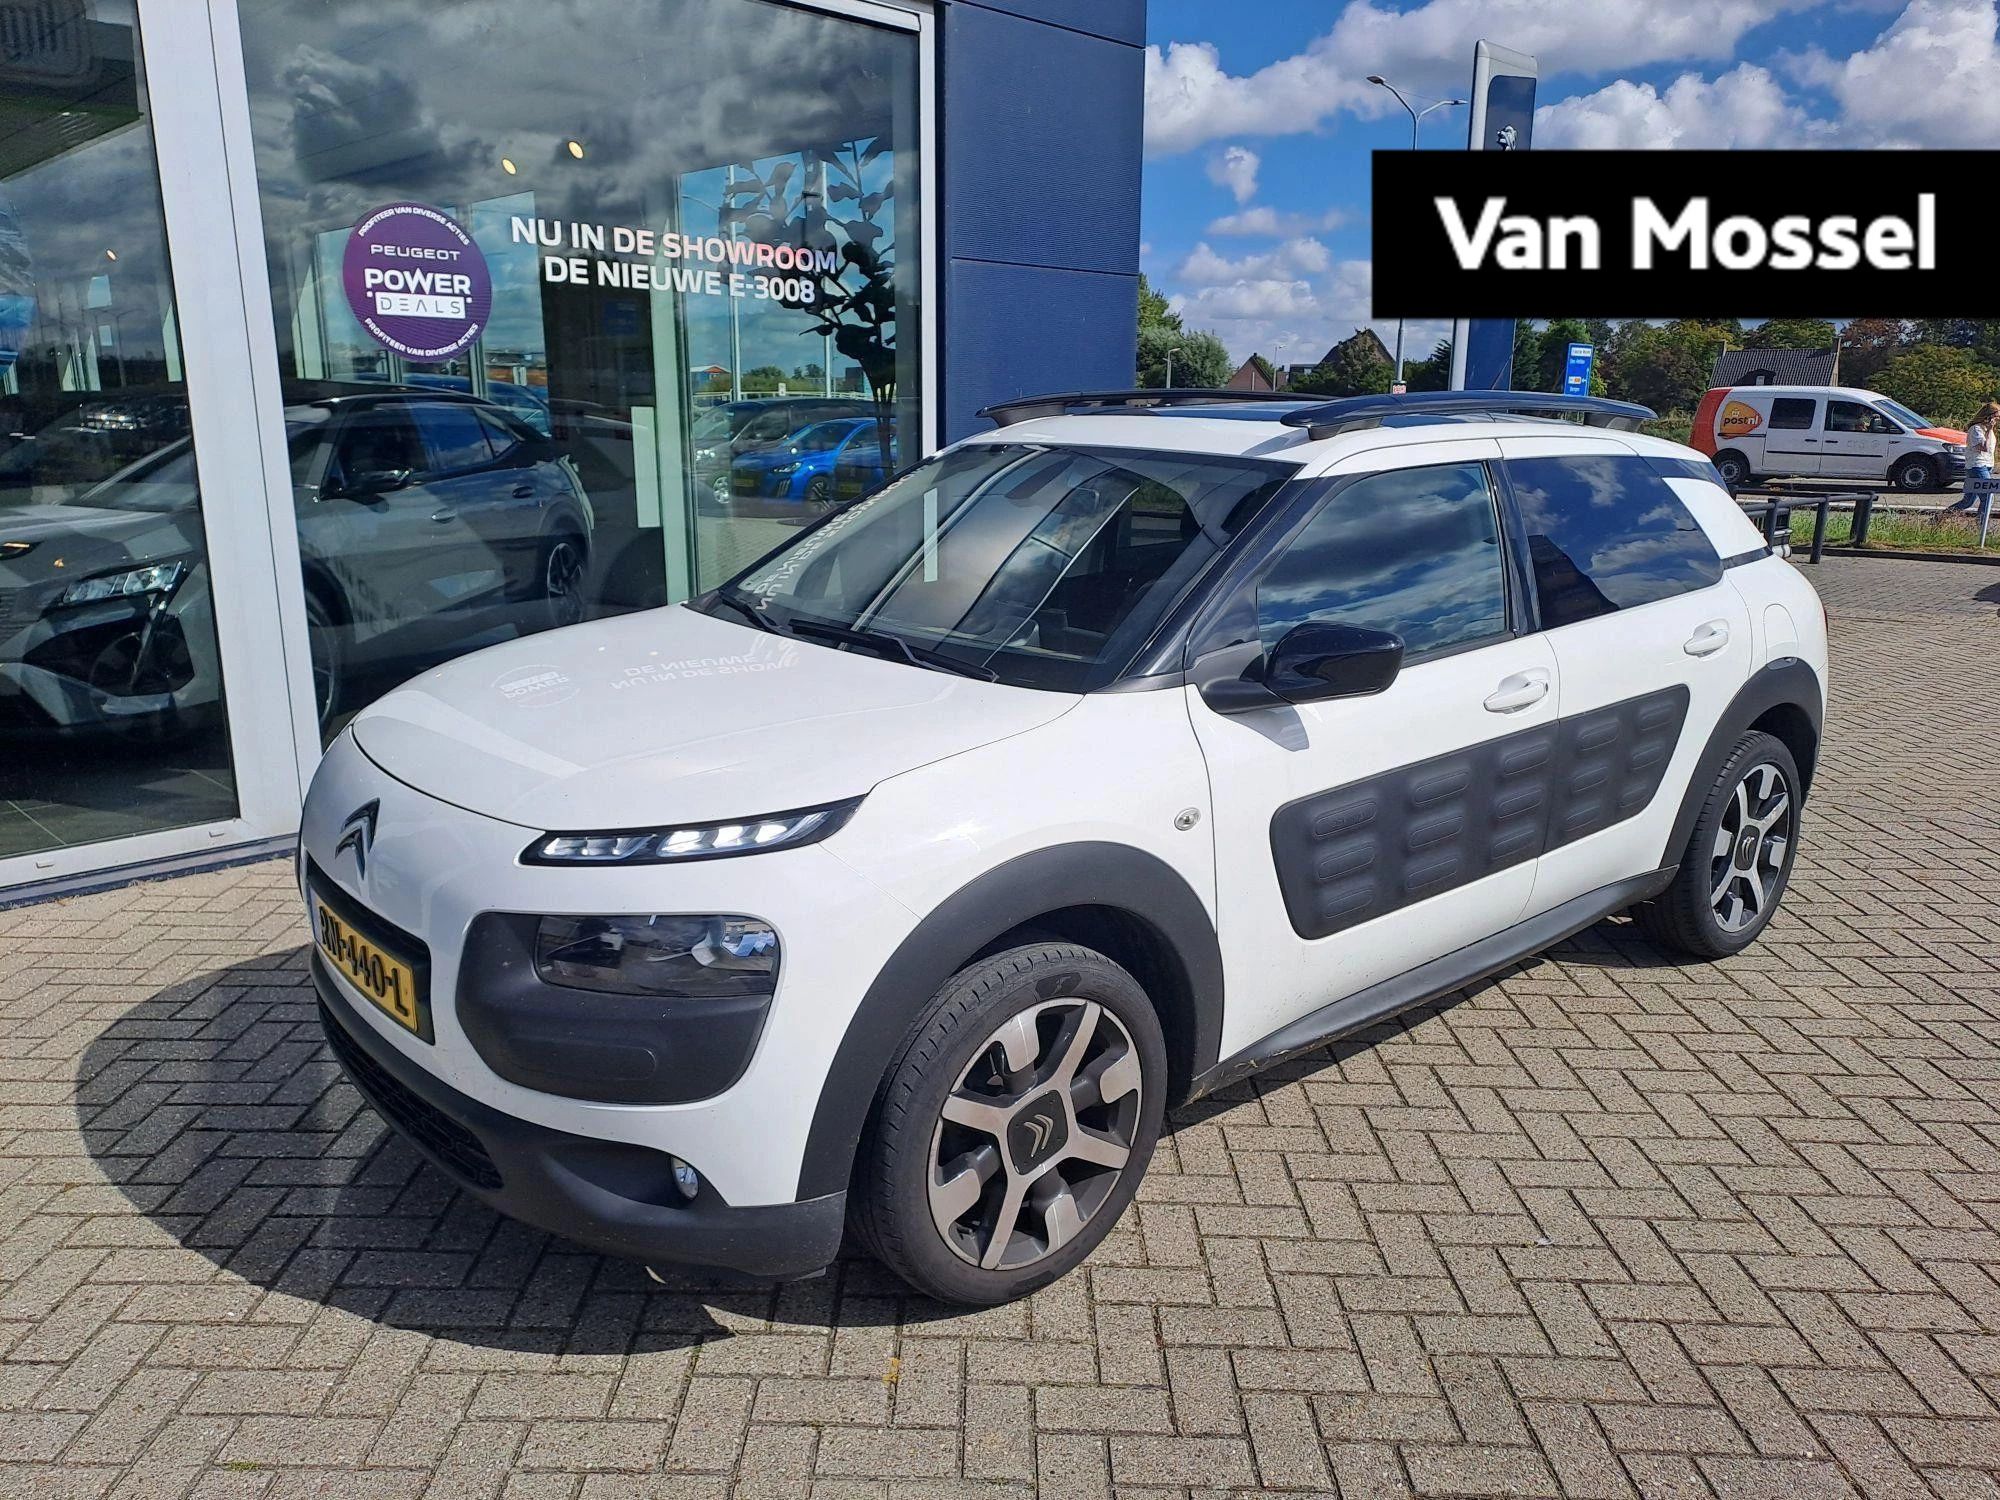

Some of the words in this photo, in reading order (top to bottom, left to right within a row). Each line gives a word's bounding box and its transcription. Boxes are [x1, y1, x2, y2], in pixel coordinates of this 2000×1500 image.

[358, 208, 395, 238] PROFITEER
[394, 206, 412, 215] VAN
[413, 207, 447, 225] DIVERSE
[445, 221, 471, 246] ACTIES
[370, 244, 461, 261] PEUGEOT
[510, 216, 562, 246] NU
[570, 222, 605, 251] IN
[613, 227, 655, 256] DE
[662, 232, 836, 274] SHOWROOM
[364, 267, 472, 295] POWER
[544, 255, 590, 285] DE
[596, 260, 722, 296] NIEUWE
[728, 273, 816, 304] E-3008
[380, 297, 461, 314] DEALS
[364, 317, 406, 352] PROFITEER
[406, 346, 425, 357] VAN
[425, 341, 459, 357] DIVERSE
[458, 322, 479, 346] ACTIES
[1724, 415, 1759, 427] postnl
